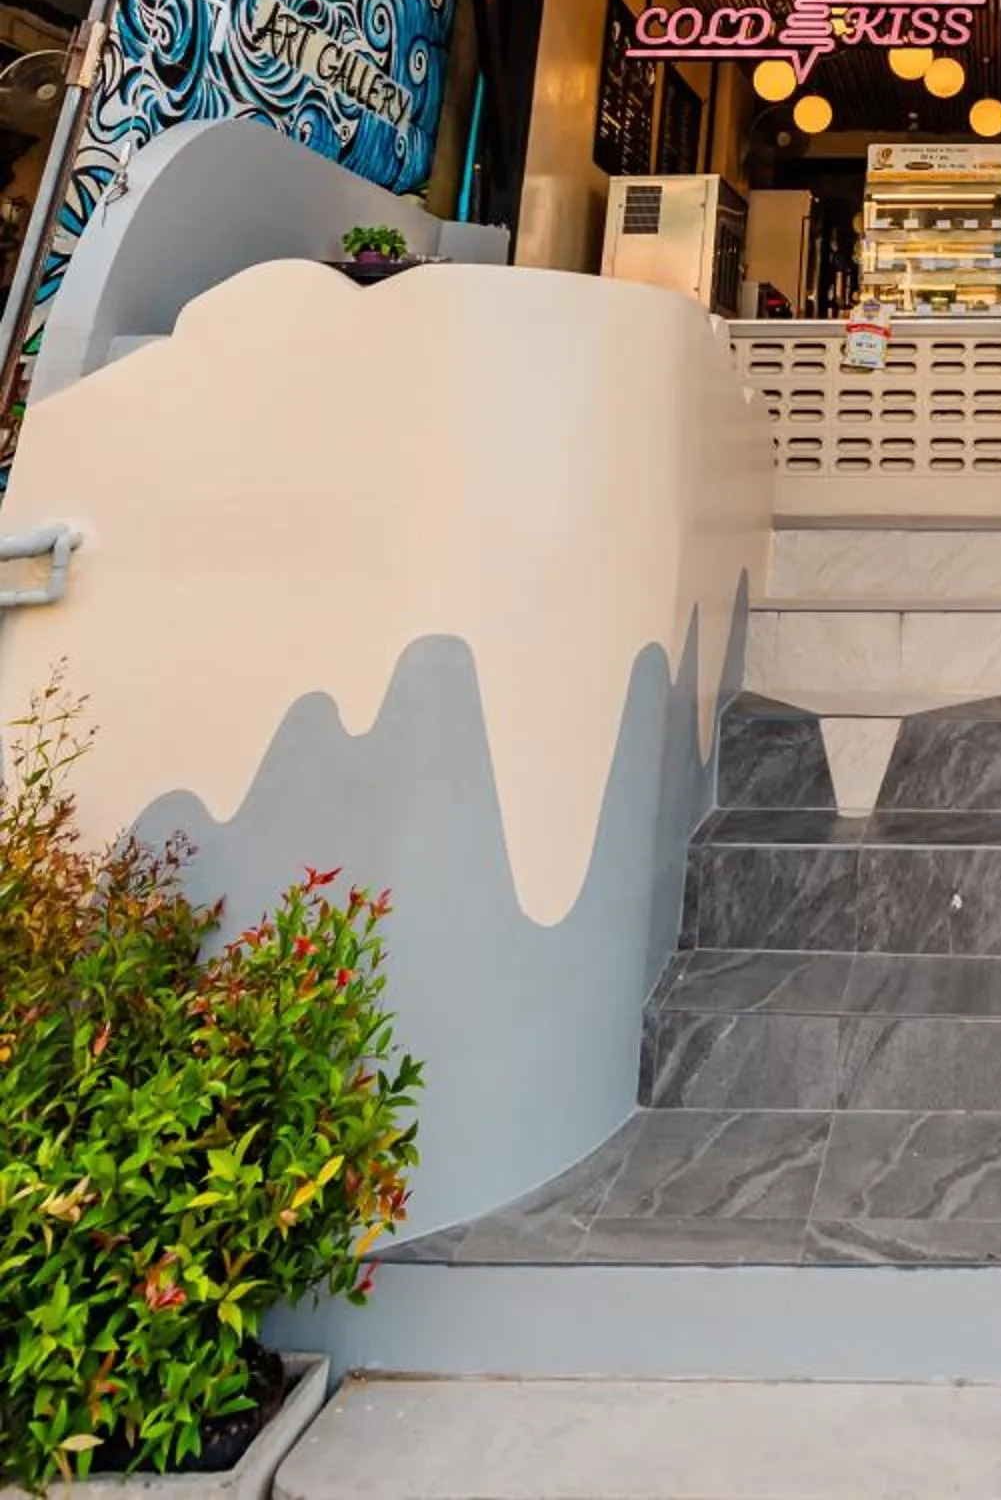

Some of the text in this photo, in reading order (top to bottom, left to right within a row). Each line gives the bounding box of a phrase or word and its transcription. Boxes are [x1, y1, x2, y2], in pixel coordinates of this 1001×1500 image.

[252, 2, 411, 126] ART GALLERY
[634, 6, 974, 46] COLD KISS
